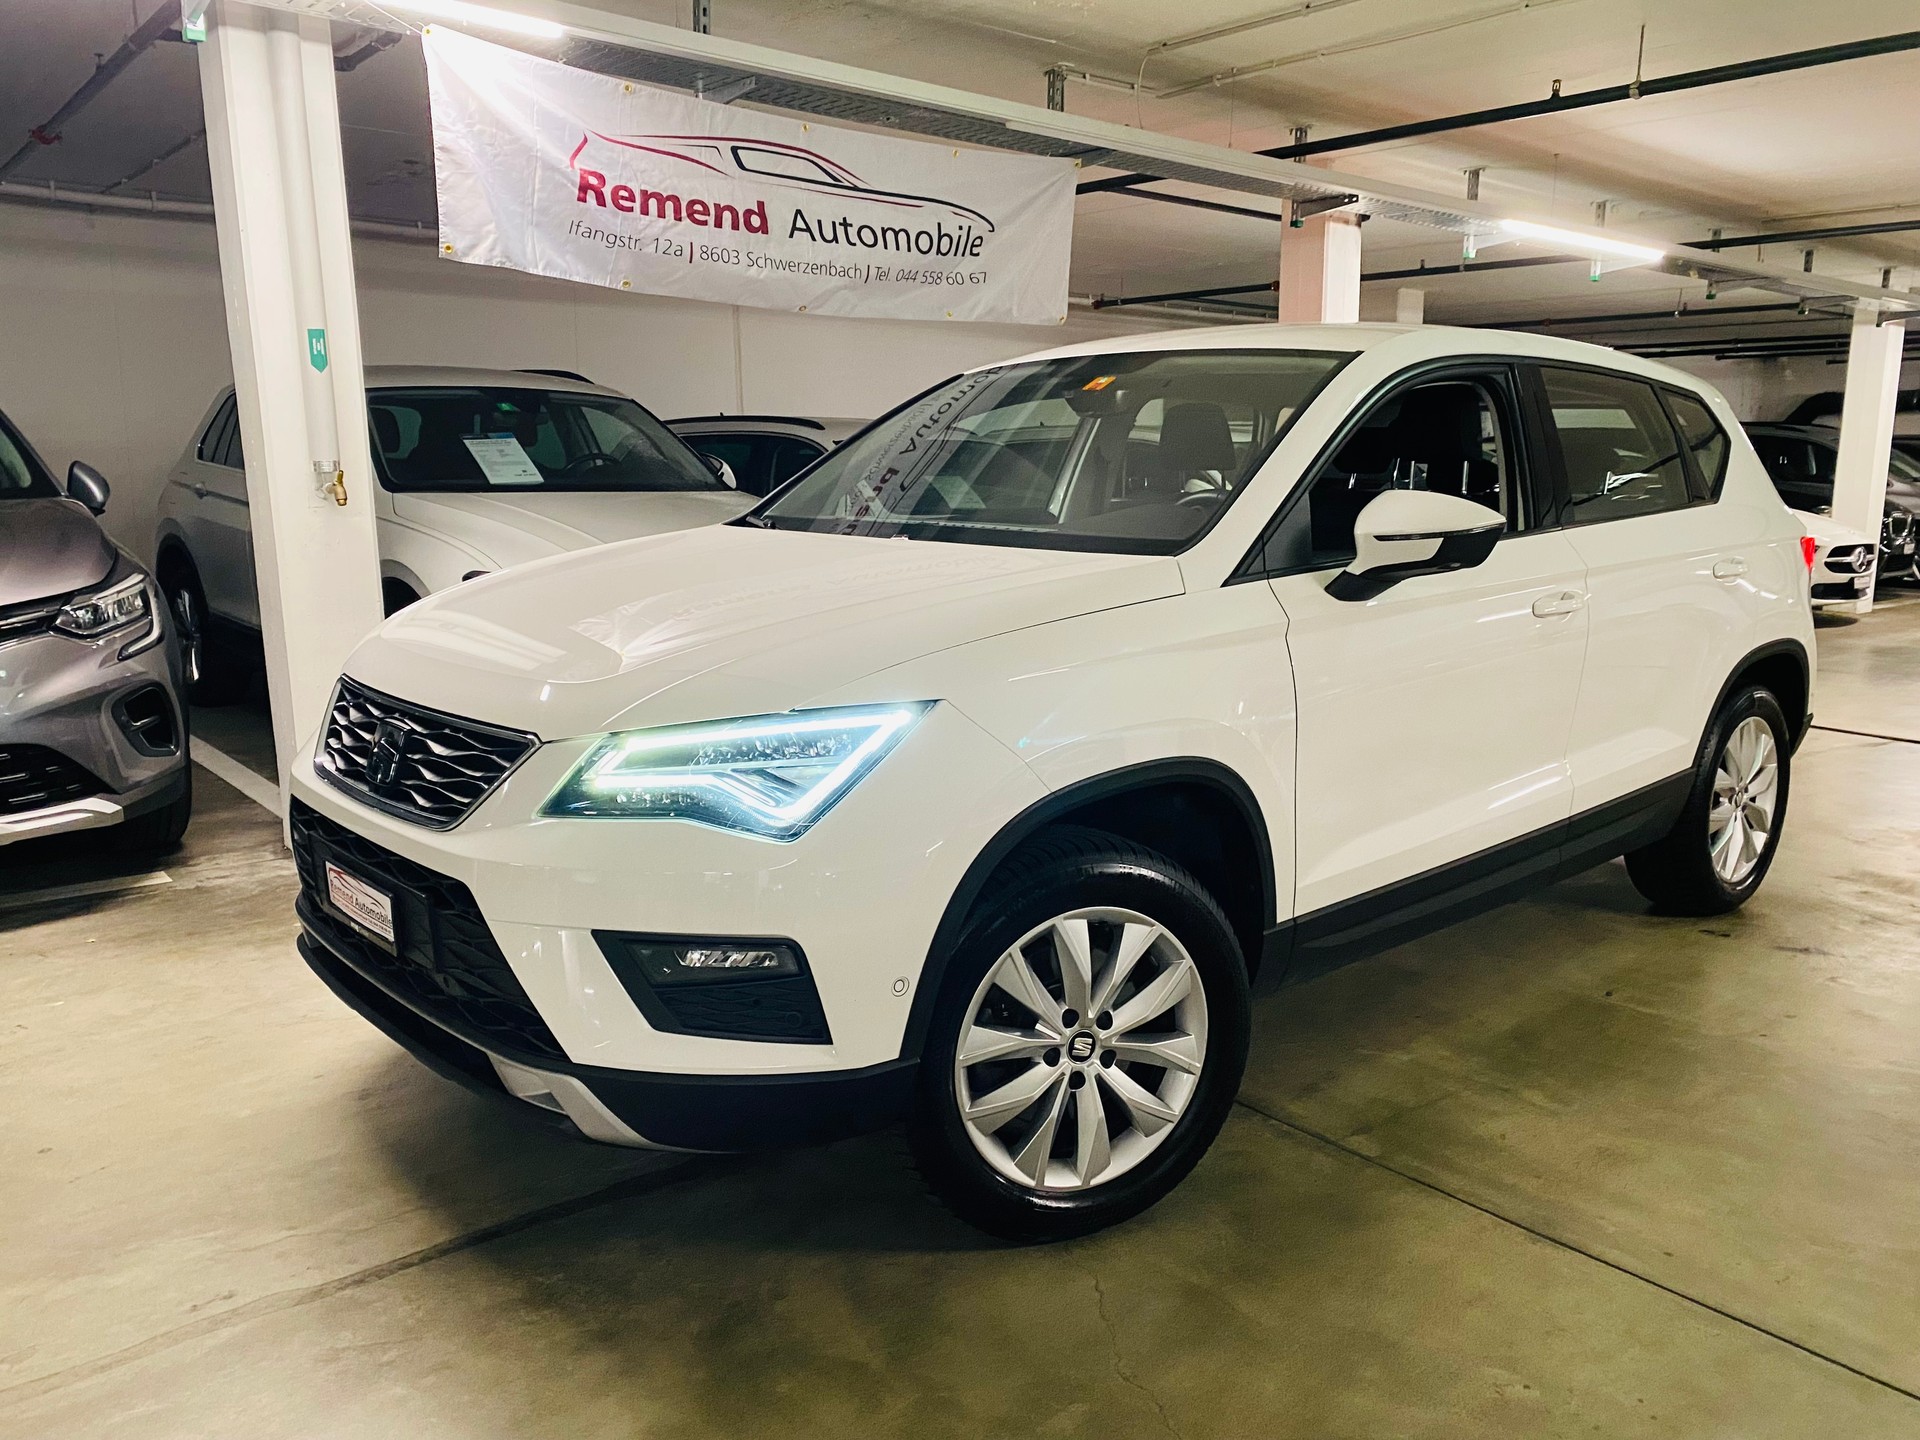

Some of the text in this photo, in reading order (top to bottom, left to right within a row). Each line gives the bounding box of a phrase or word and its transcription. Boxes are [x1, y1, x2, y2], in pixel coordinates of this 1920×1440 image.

[576, 168, 984, 258] Remend Automobile
[568, 219, 987, 286] Ifangstr. 12a 8603 Schwerzenbach Tel. 044 558 60 67
